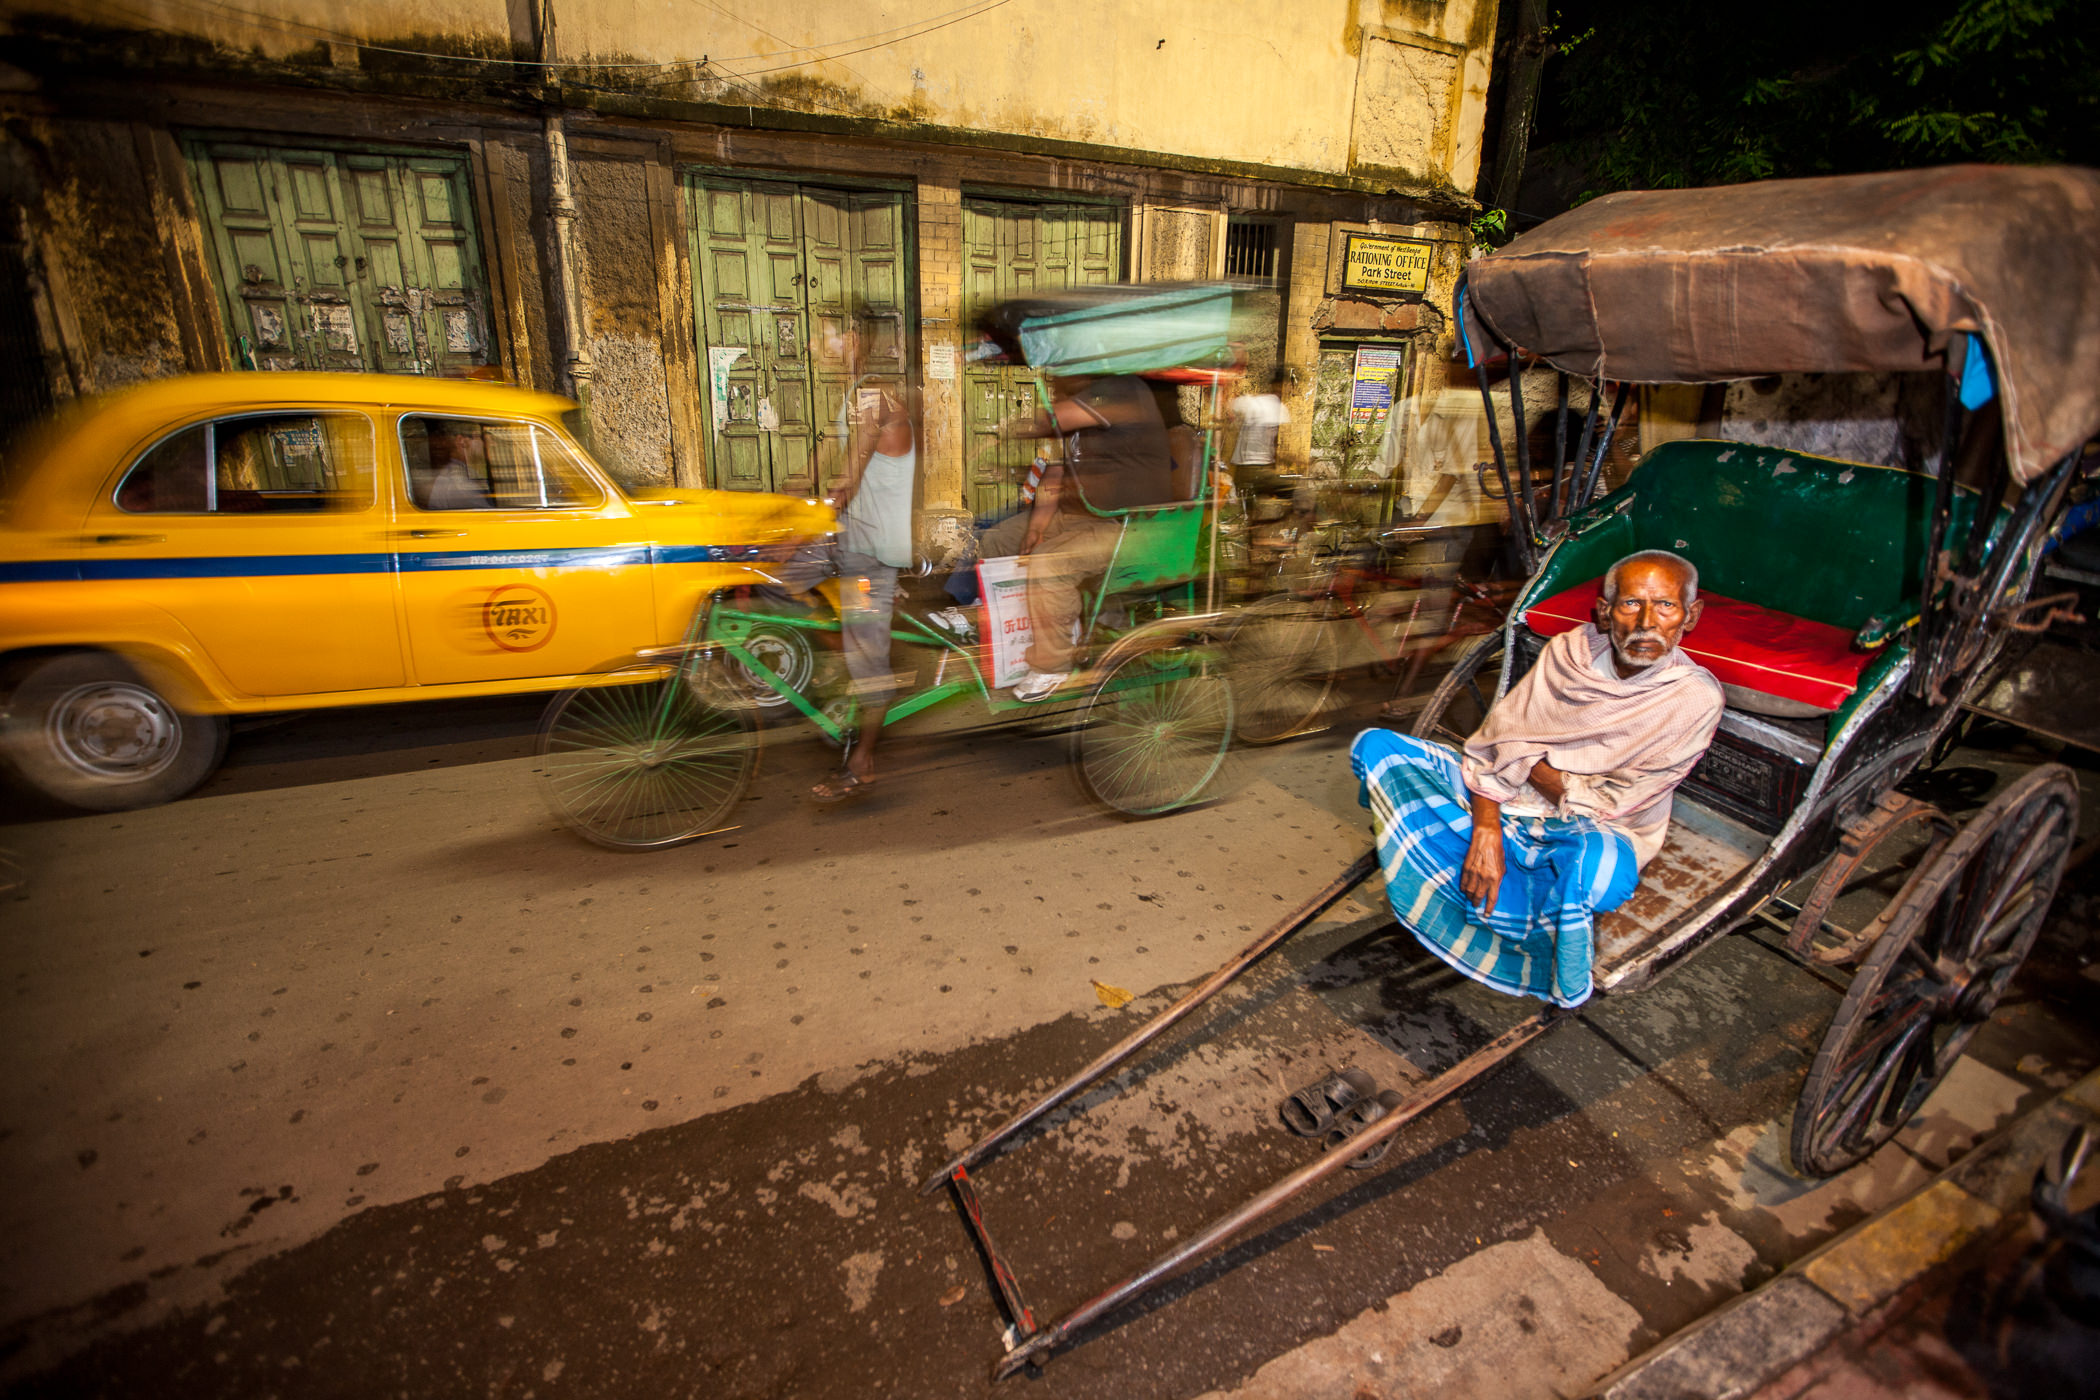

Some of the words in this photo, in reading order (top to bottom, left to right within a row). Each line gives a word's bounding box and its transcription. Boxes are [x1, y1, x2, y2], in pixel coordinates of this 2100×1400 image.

[1350, 251, 1392, 266] RATIONING
[1396, 255, 1427, 269] OFFICE
[1362, 266, 1381, 278] Park
[1384, 268, 1412, 280] Street
[490, 599, 548, 626] TAXI
